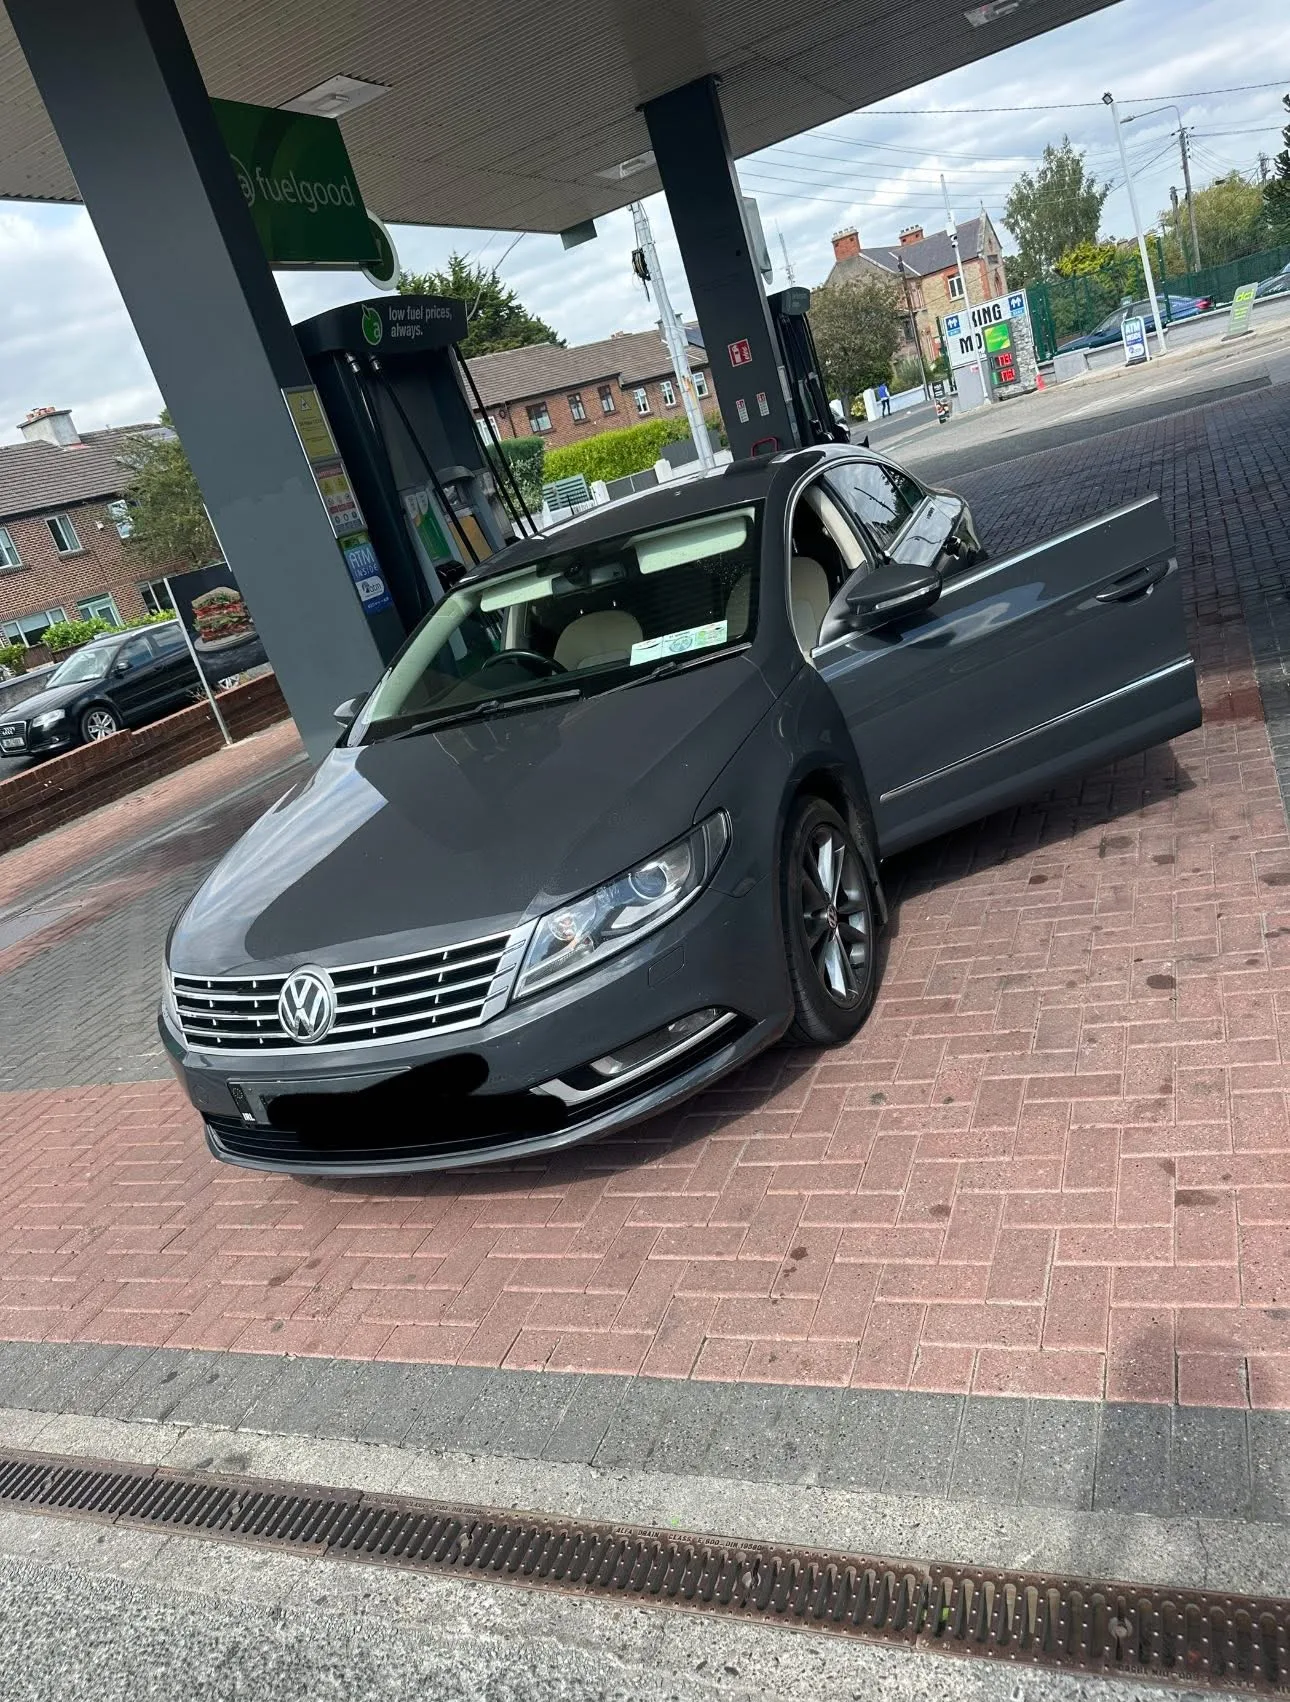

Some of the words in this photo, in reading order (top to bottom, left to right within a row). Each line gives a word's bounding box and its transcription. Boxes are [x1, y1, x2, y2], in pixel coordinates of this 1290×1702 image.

[255, 166, 356, 213] fuelgood
[388, 305, 405, 321] low
[407, 305, 424, 321] fuel
[425, 304, 453, 323] prices,
[390, 322, 424, 339] always.
[1125, 320, 1141, 334] ATM
[348, 547, 376, 570] ATM
[353, 563, 379, 579] INSIDE
[616, 1527, 633, 1536] ALFA
[637, 1530, 660, 1538] DRAIN
[668, 1533, 692, 1542] CLASS
